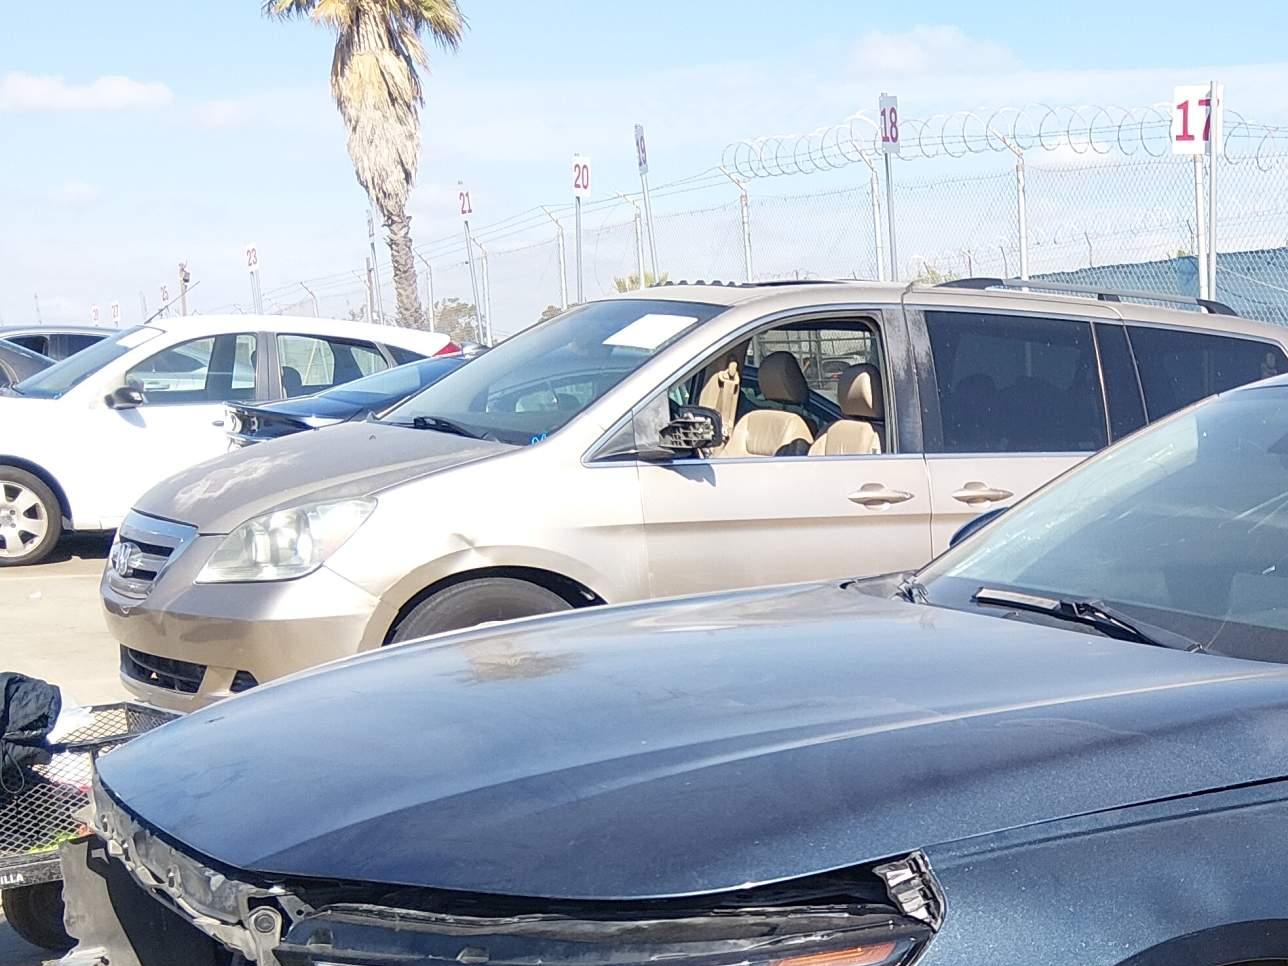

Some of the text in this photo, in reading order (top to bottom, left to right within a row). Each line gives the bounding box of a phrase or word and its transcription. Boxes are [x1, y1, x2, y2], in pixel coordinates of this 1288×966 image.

[880, 106, 898, 143] 18
[1175, 98, 1219, 141] 17
[636, 135, 647, 167] 19
[574, 163, 589, 189] 20
[460, 191, 472, 214] 21
[246, 248, 258, 267] 23
